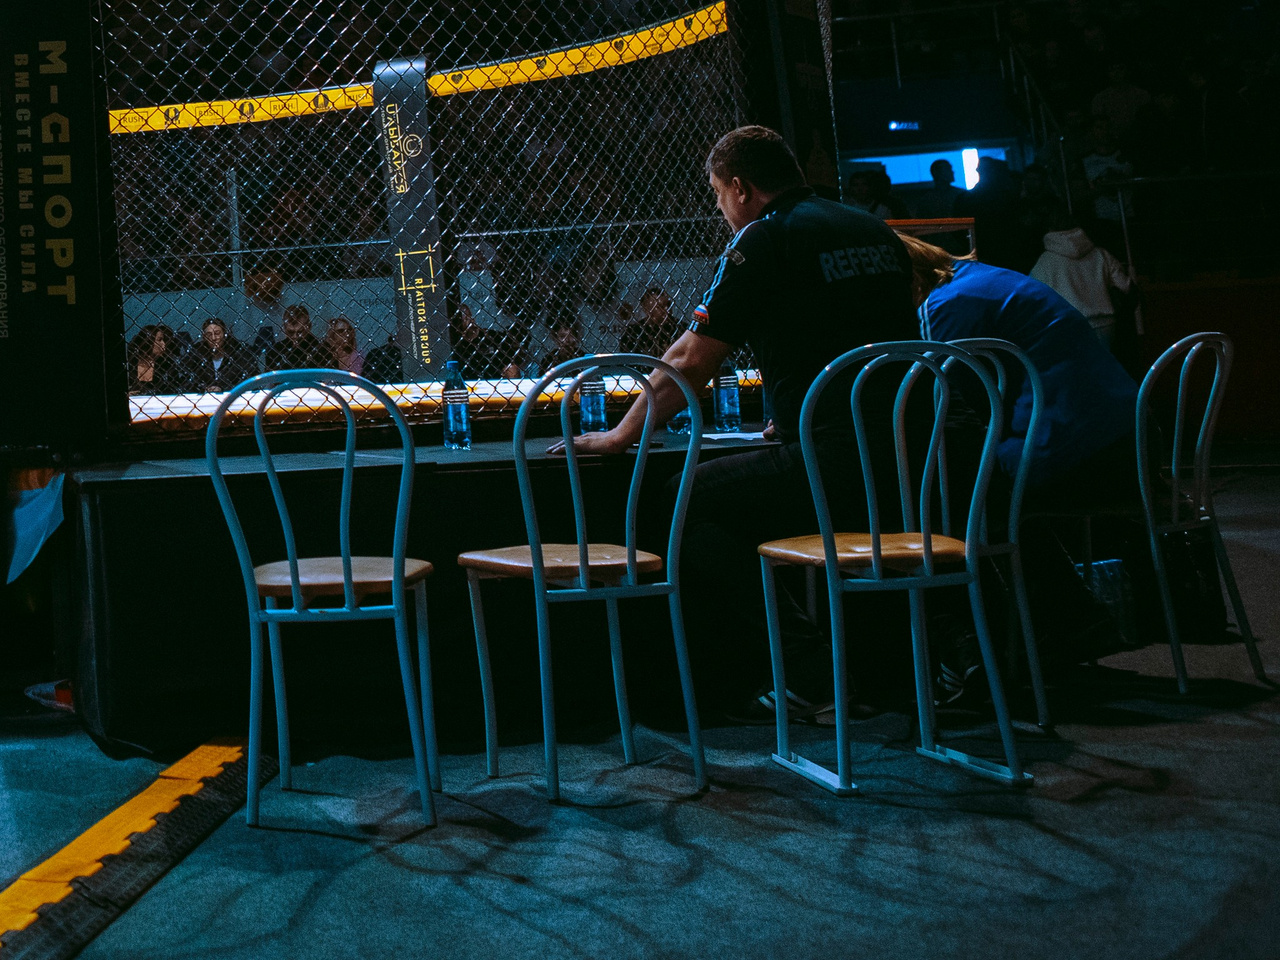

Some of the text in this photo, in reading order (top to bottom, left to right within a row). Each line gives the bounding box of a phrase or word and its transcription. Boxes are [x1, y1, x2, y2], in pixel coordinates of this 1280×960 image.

[13, 52, 38, 294] ВМЕСТЕ МЫ СИЛА
[38, 40, 77, 306] М-СПОРТ
[419, 328, 431, 364] GROUP
